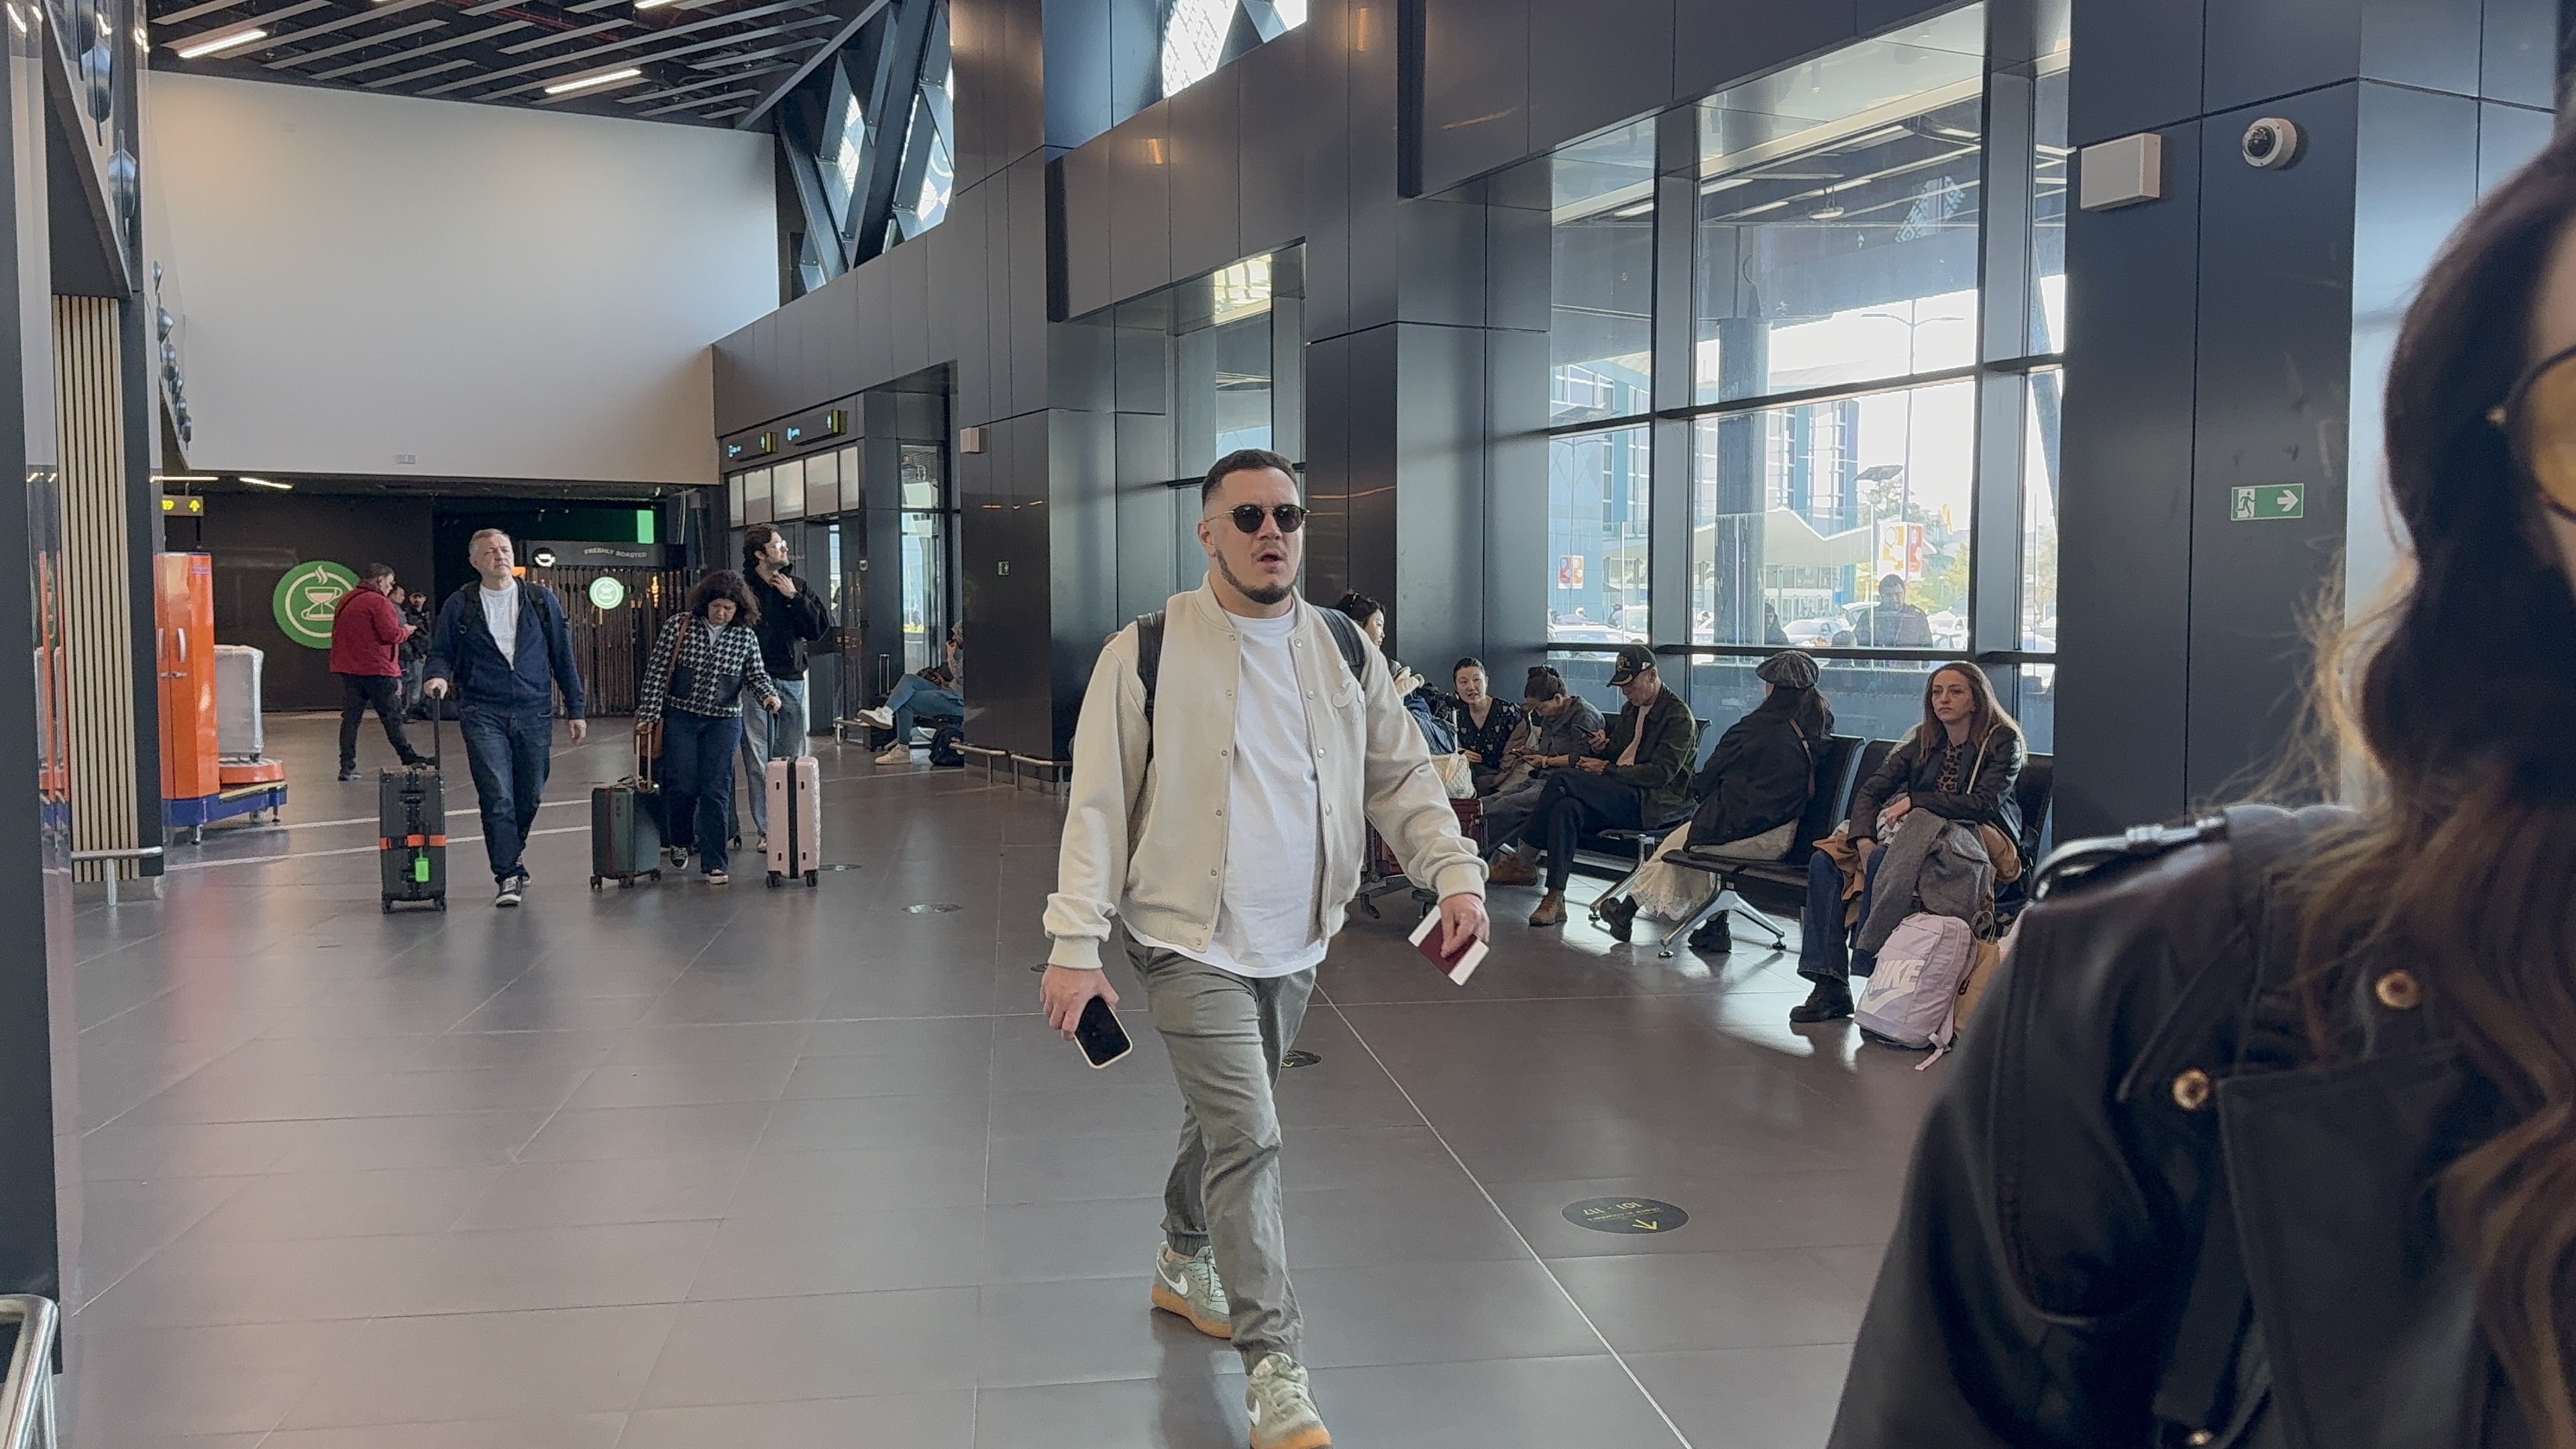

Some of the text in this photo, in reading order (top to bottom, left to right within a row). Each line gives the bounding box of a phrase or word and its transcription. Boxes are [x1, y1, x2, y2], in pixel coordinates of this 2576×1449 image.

[1869, 959, 1926, 994] NIKE
[1615, 1201, 1643, 1210] 101
[1582, 1208, 1605, 1216] 117
